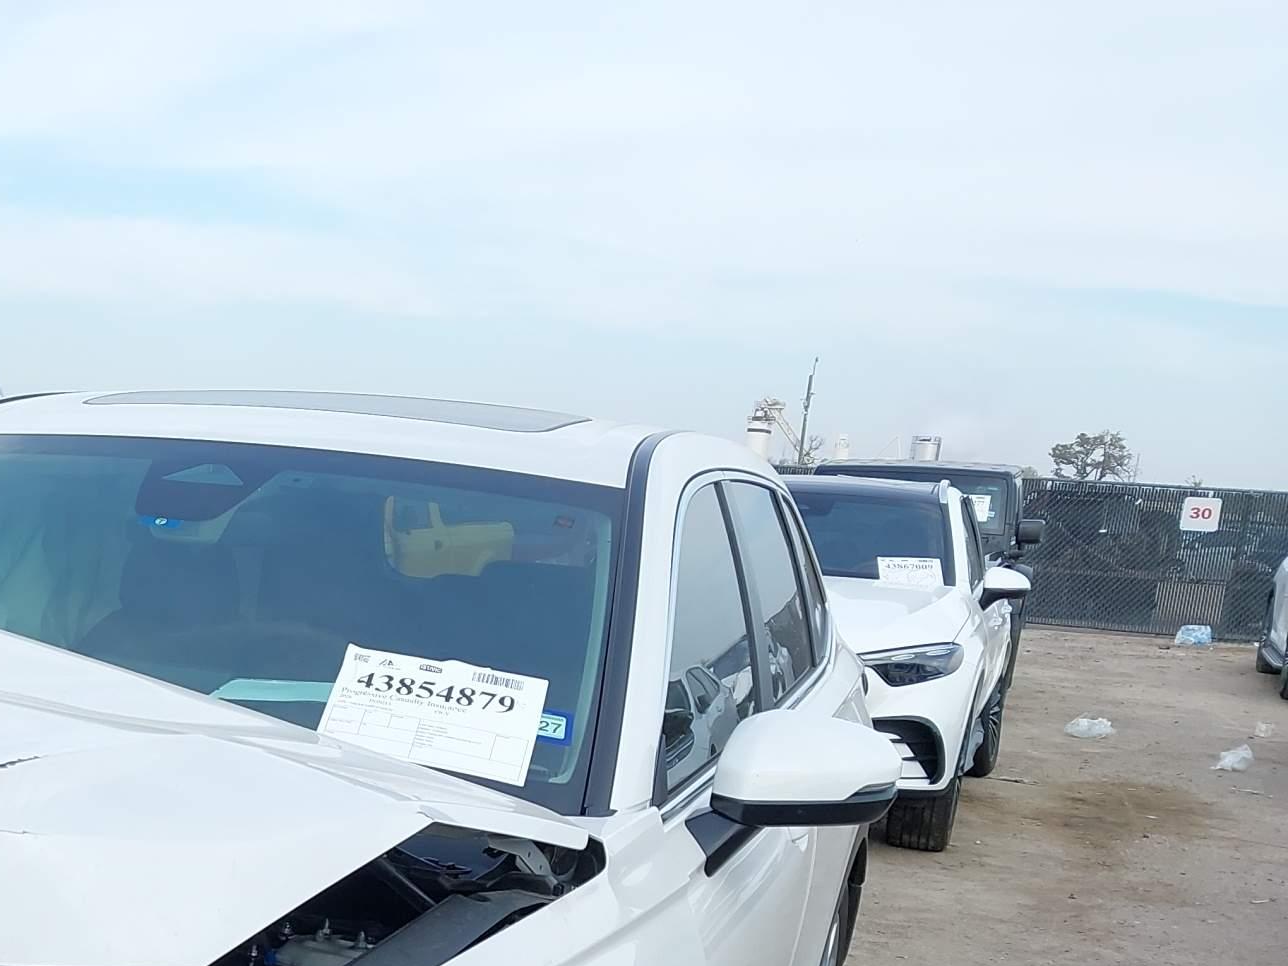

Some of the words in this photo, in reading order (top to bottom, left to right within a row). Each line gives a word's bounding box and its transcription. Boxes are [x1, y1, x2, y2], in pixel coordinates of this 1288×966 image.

[1189, 507, 1213, 520] 30
[357, 672, 516, 714] 43854879
[539, 720, 563, 734] 27
